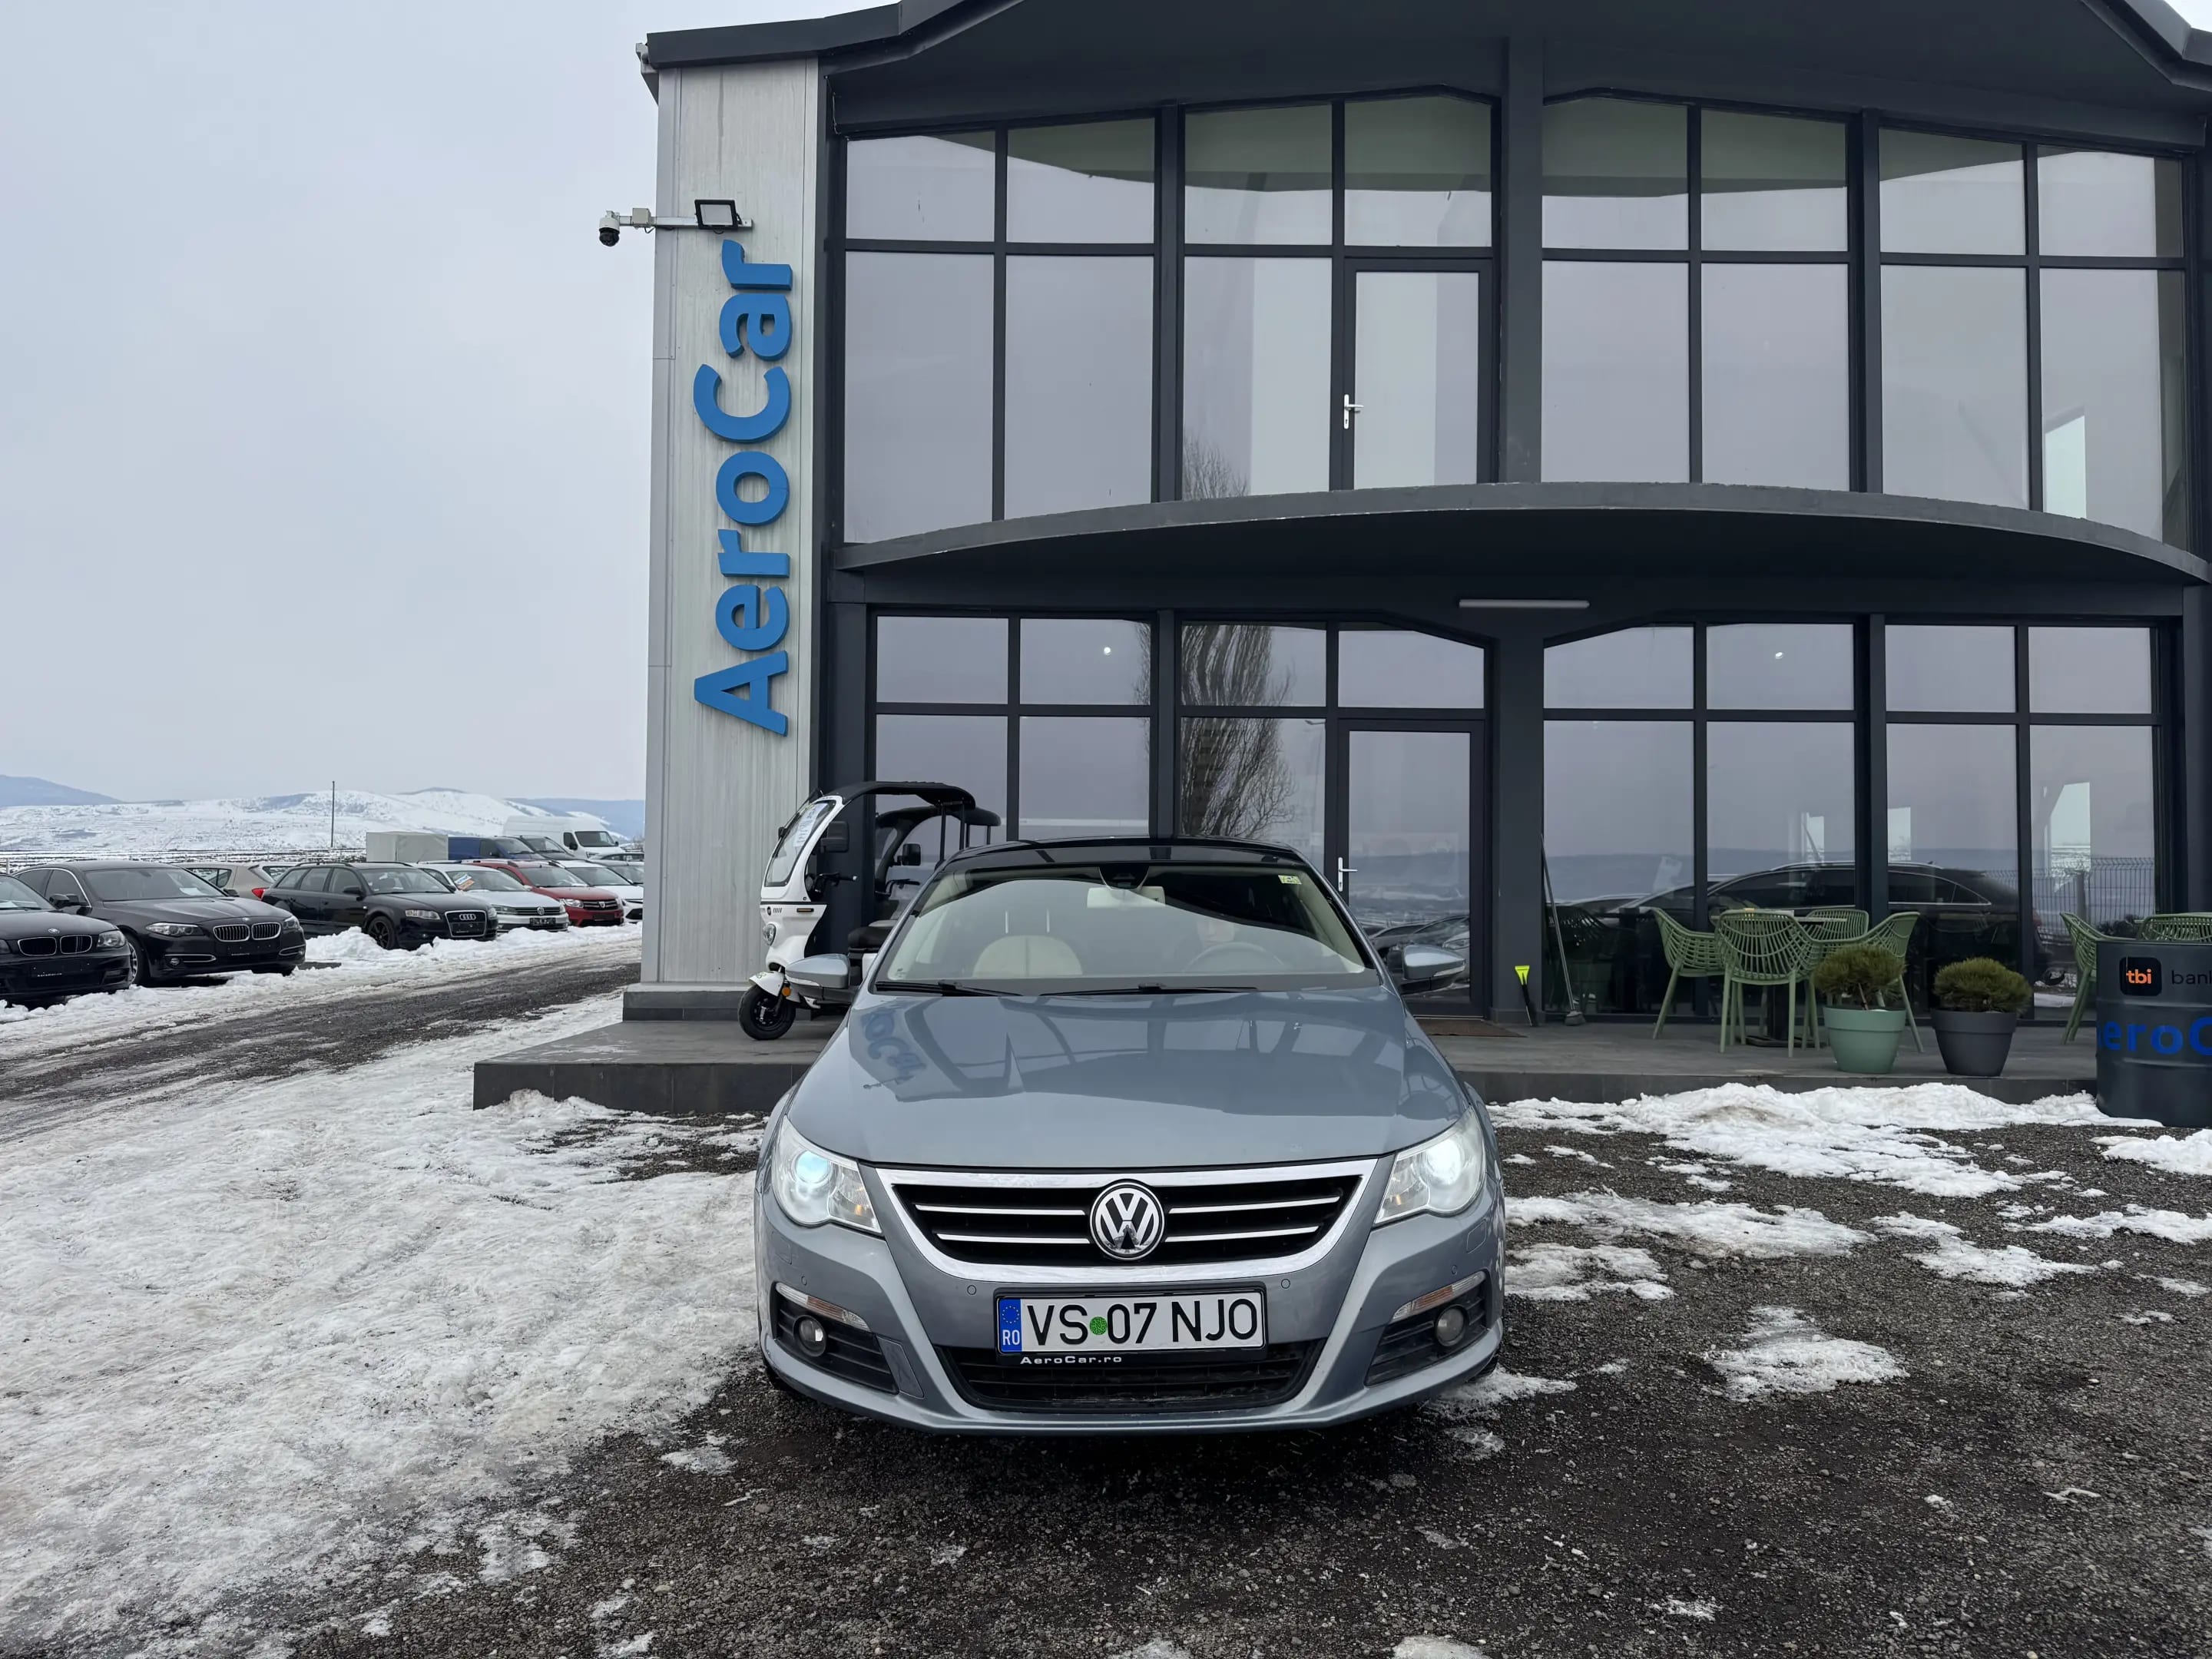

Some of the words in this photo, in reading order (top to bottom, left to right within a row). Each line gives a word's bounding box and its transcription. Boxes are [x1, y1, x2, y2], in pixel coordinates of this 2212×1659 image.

[694, 240, 793, 735] AeroCar
[2126, 969, 2151, 984] tbi
[2171, 970, 2212, 984] ban
[2097, 1017, 2212, 1056] eroC
[1027, 1304, 1088, 1346] VS
[1107, 1303, 1157, 1345] 07
[1171, 1299, 1258, 1343] NJO
[1002, 1330, 1020, 1346] RO
[1020, 1356, 1122, 1365] AeroCar.ro
